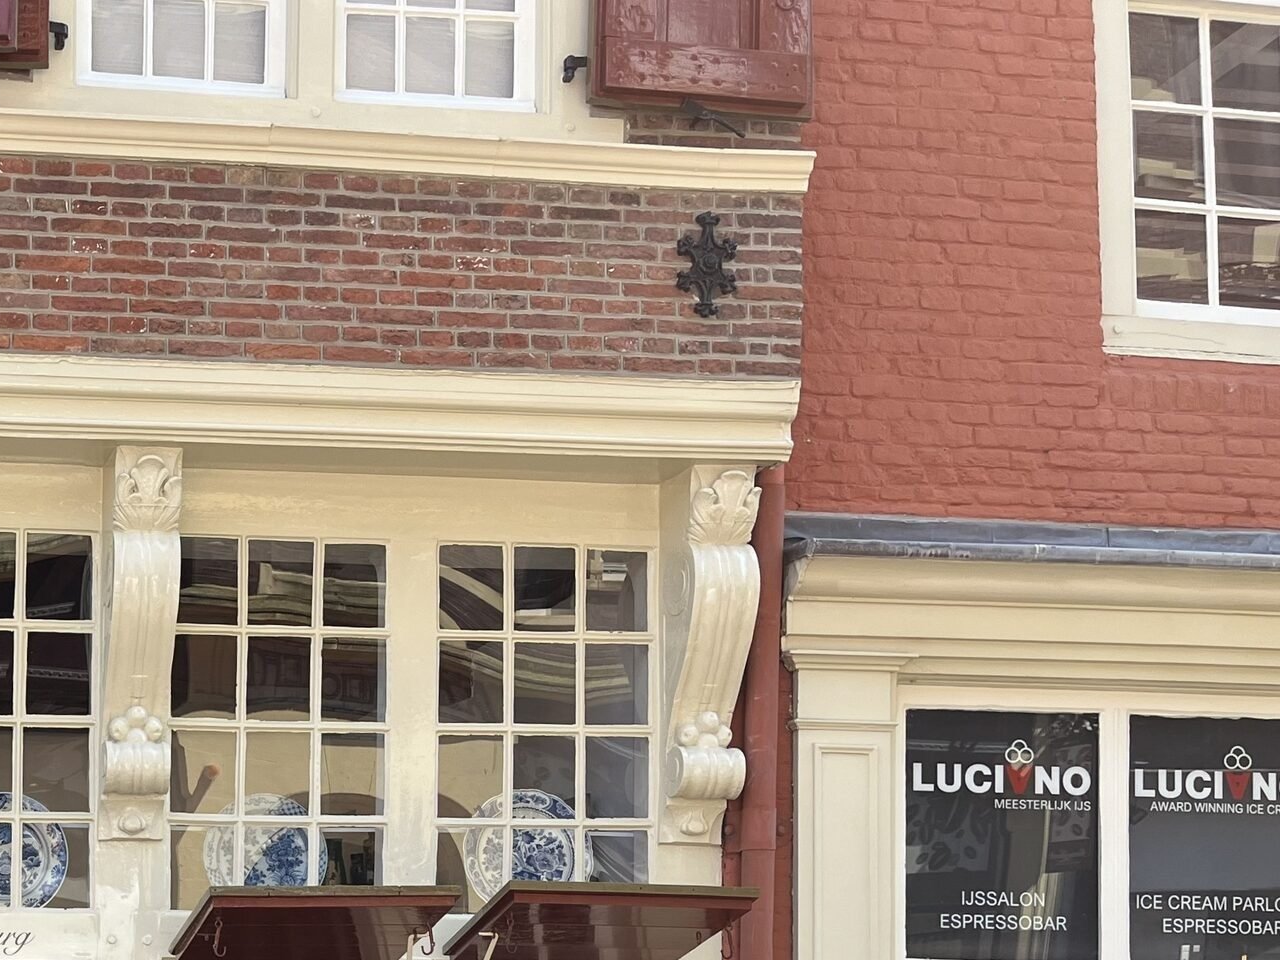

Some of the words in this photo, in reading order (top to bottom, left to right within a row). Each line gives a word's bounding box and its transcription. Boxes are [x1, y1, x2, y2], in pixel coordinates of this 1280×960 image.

[1134, 768, 1280, 801] LUCIN
[994, 798, 1071, 811] MEESTERLIJK
[1073, 800, 1092, 812] IJS
[1149, 801, 1193, 813] AWARD
[1194, 802, 1244, 815] WINNING
[1246, 803, 1264, 815] ICE
[961, 890, 1046, 908] IJSSALON
[1135, 894, 1163, 910] ICE
[1167, 894, 1228, 911] CREAM
[939, 913, 1067, 931] ESPRESSOBAR
